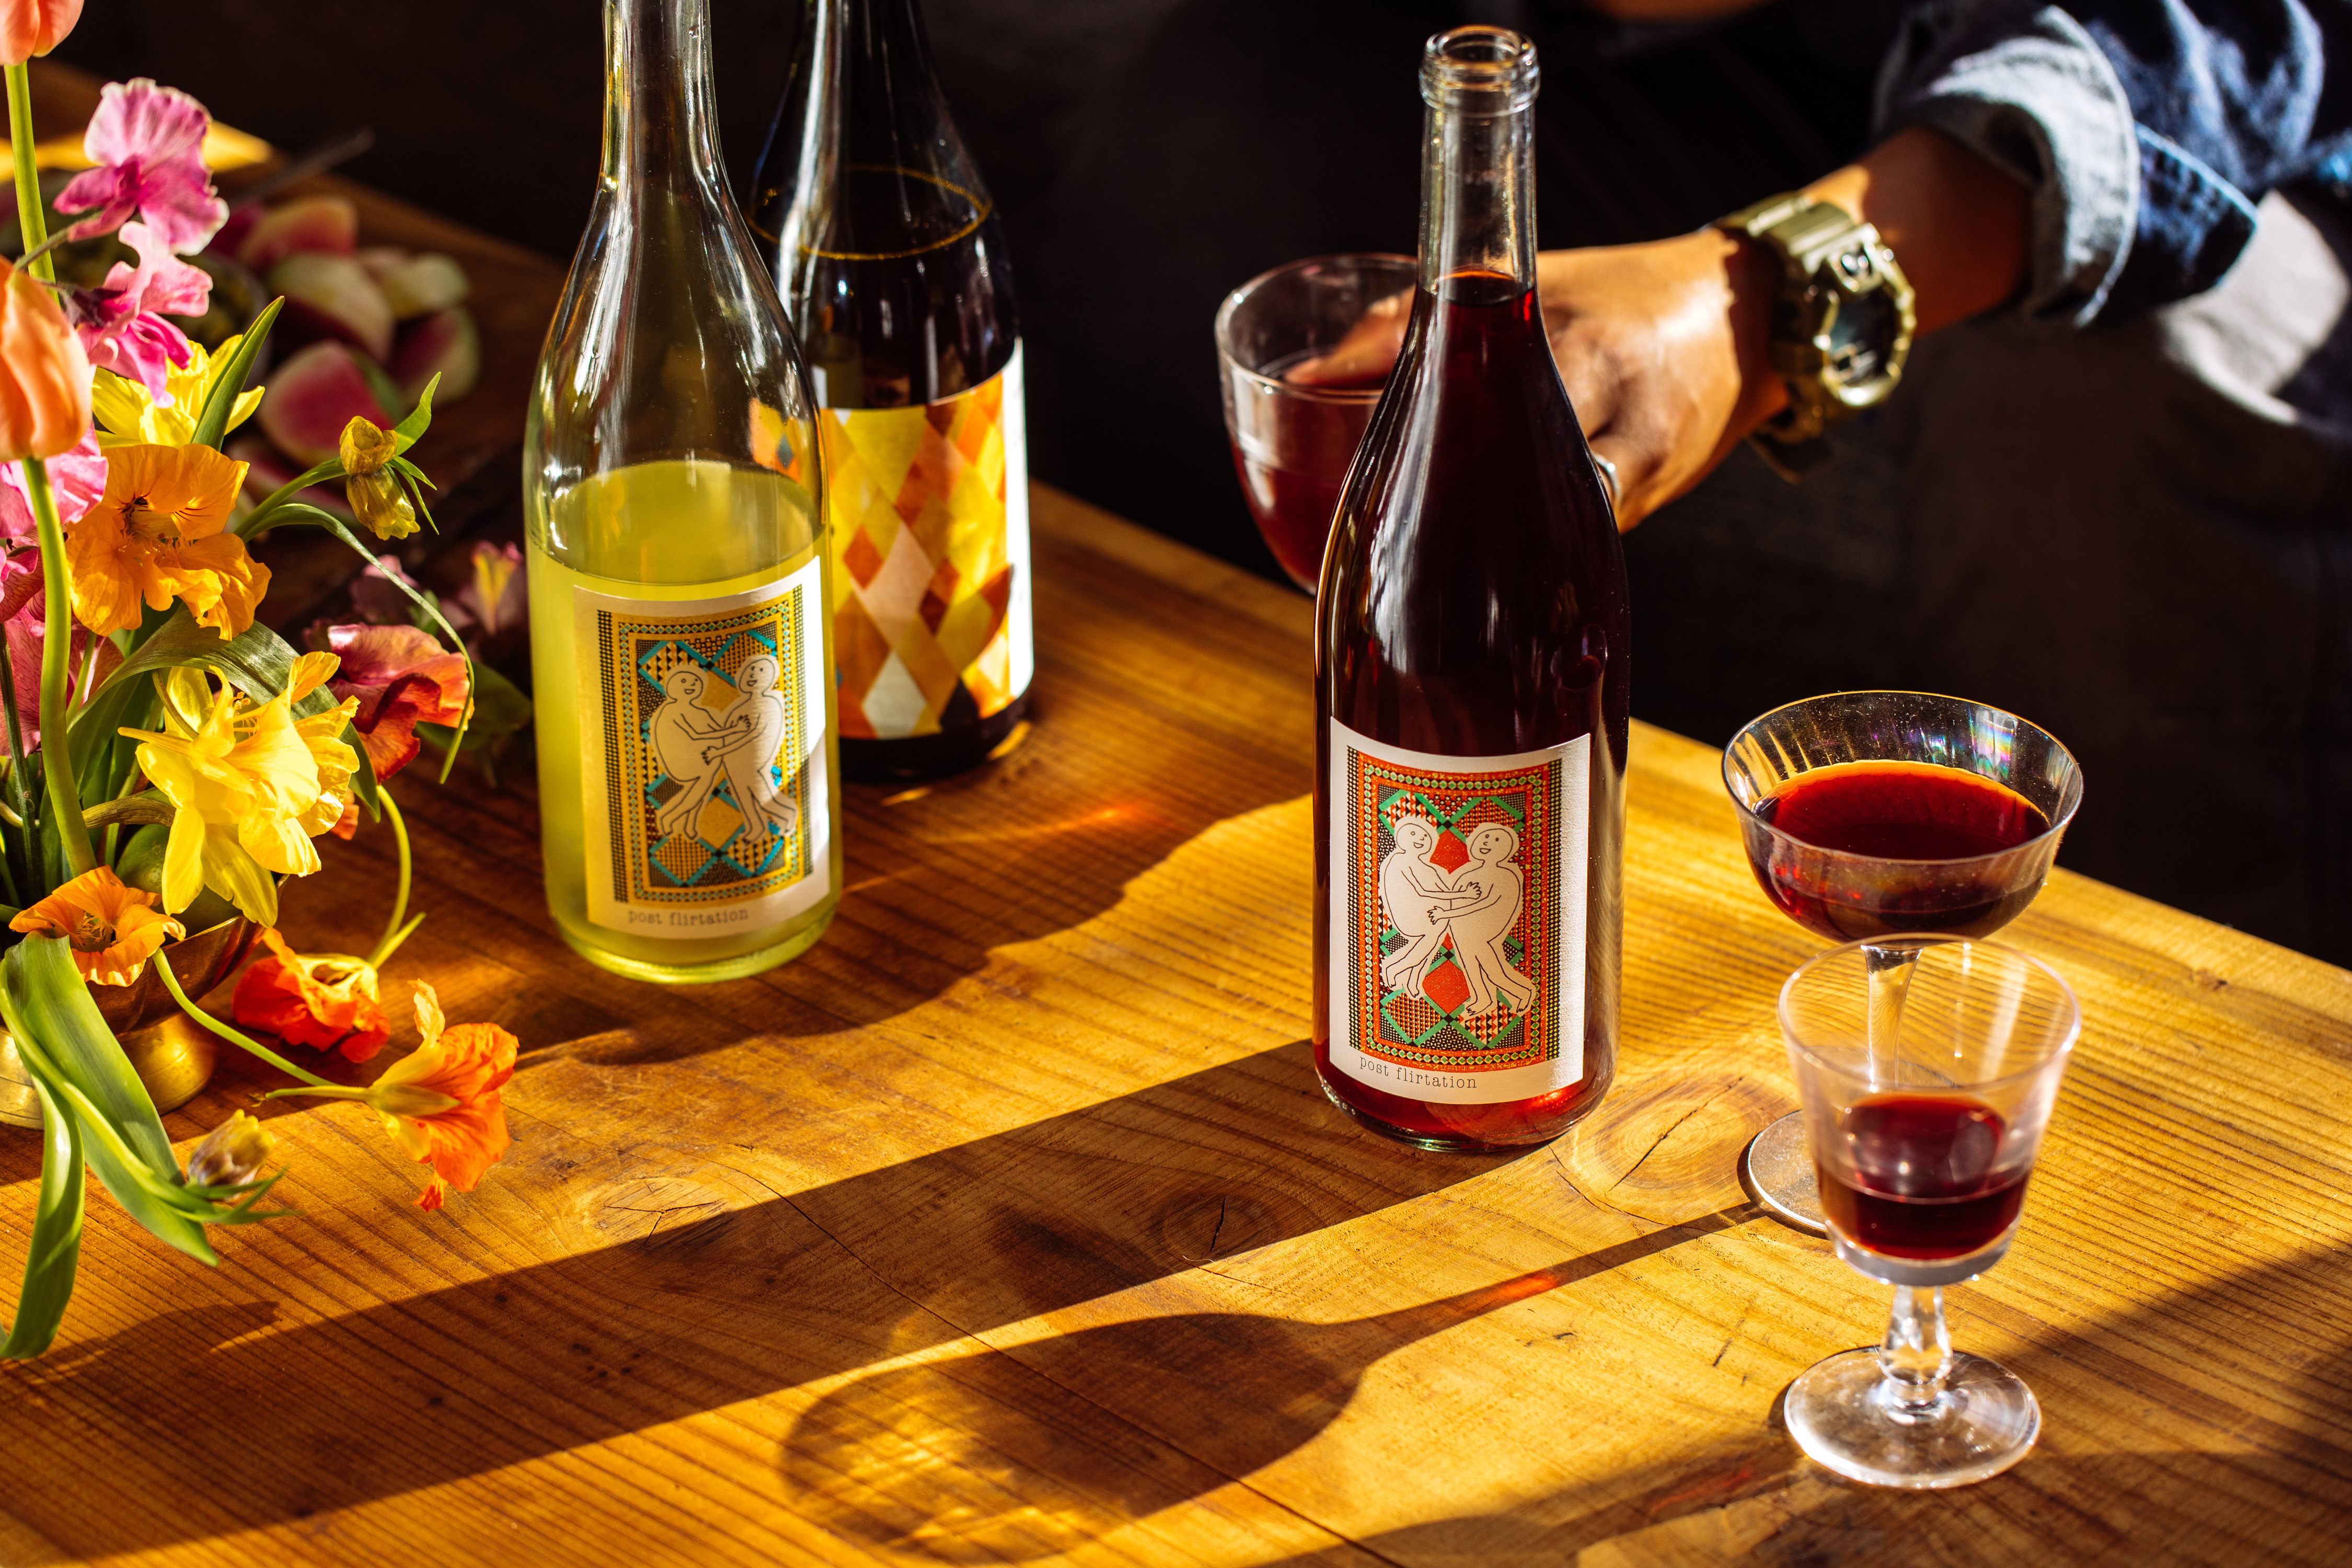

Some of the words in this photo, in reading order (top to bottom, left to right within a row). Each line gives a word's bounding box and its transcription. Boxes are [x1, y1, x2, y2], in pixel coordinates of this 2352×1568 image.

[628, 911, 662, 924] post
[670, 909, 748, 926] flirtation
[1360, 1056, 1388, 1076] post
[1396, 1068, 1477, 1088] flirtation
